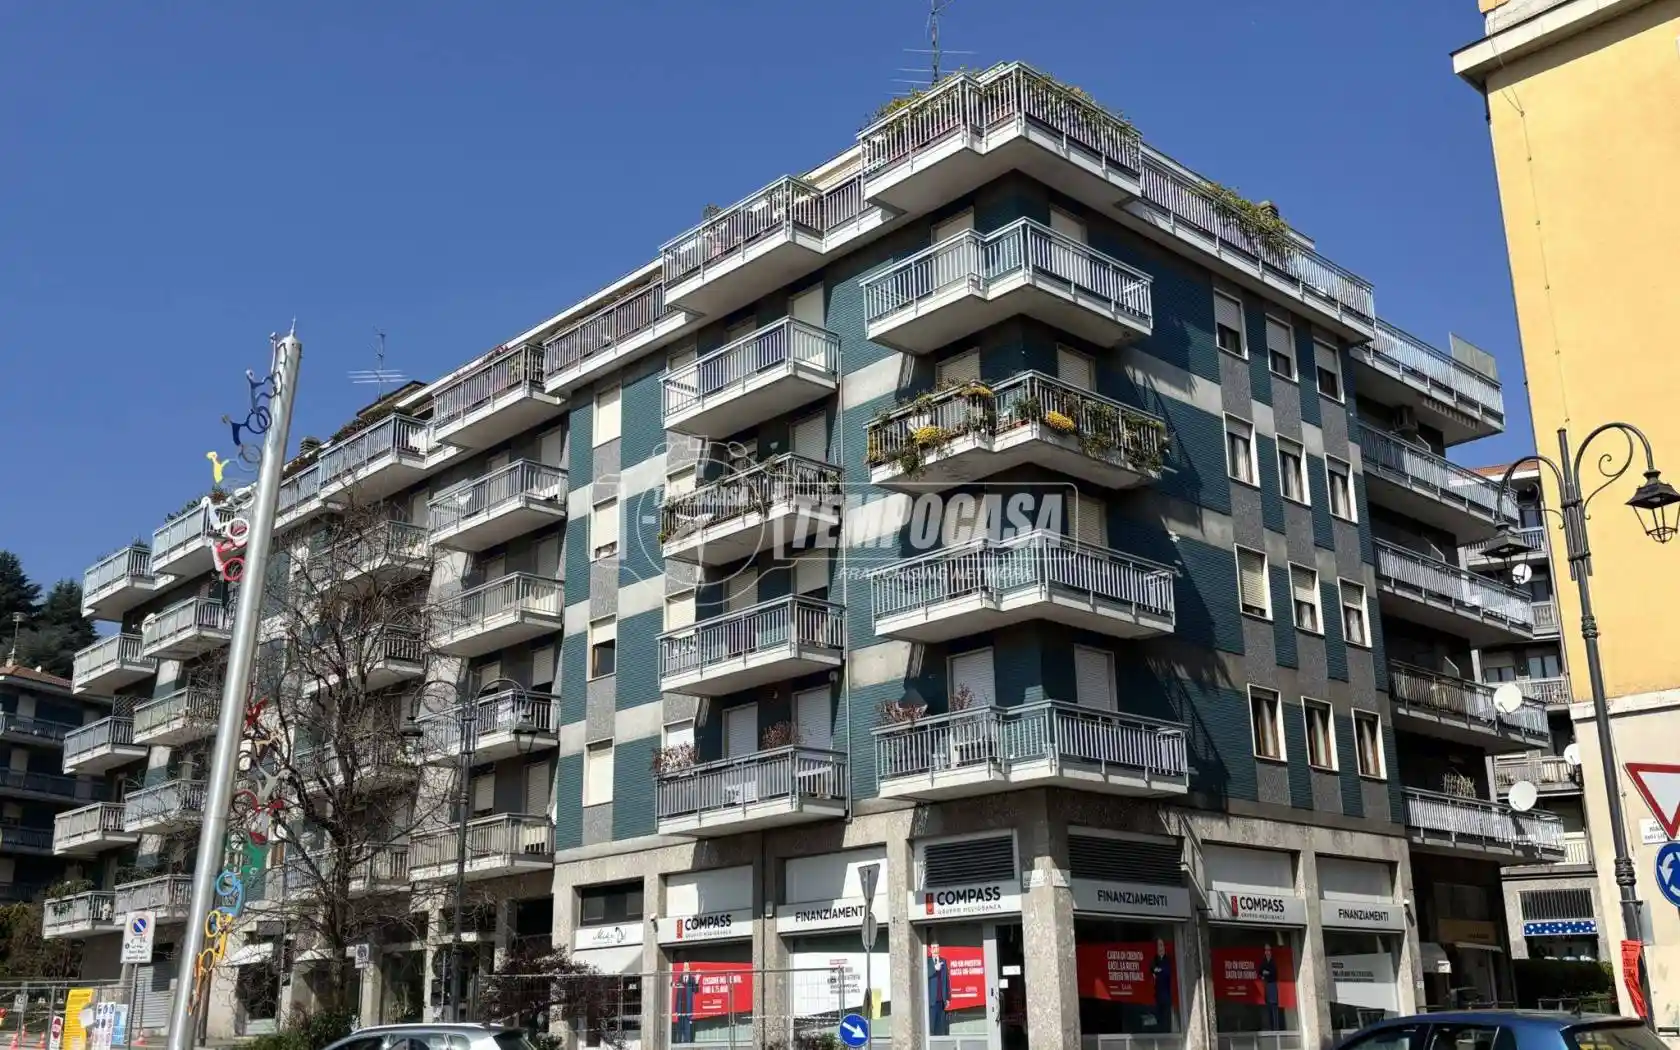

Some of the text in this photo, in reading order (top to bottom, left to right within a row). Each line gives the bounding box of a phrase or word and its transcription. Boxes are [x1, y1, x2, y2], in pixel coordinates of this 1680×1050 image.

[937, 886, 1001, 906] COMPASS
[1097, 889, 1168, 907] FINANZIAMENTI
[1240, 896, 1285, 913] COMPASS
[685, 914, 732, 931] COMPASS
[1338, 908, 1389, 922] FINANZIAMENTI
